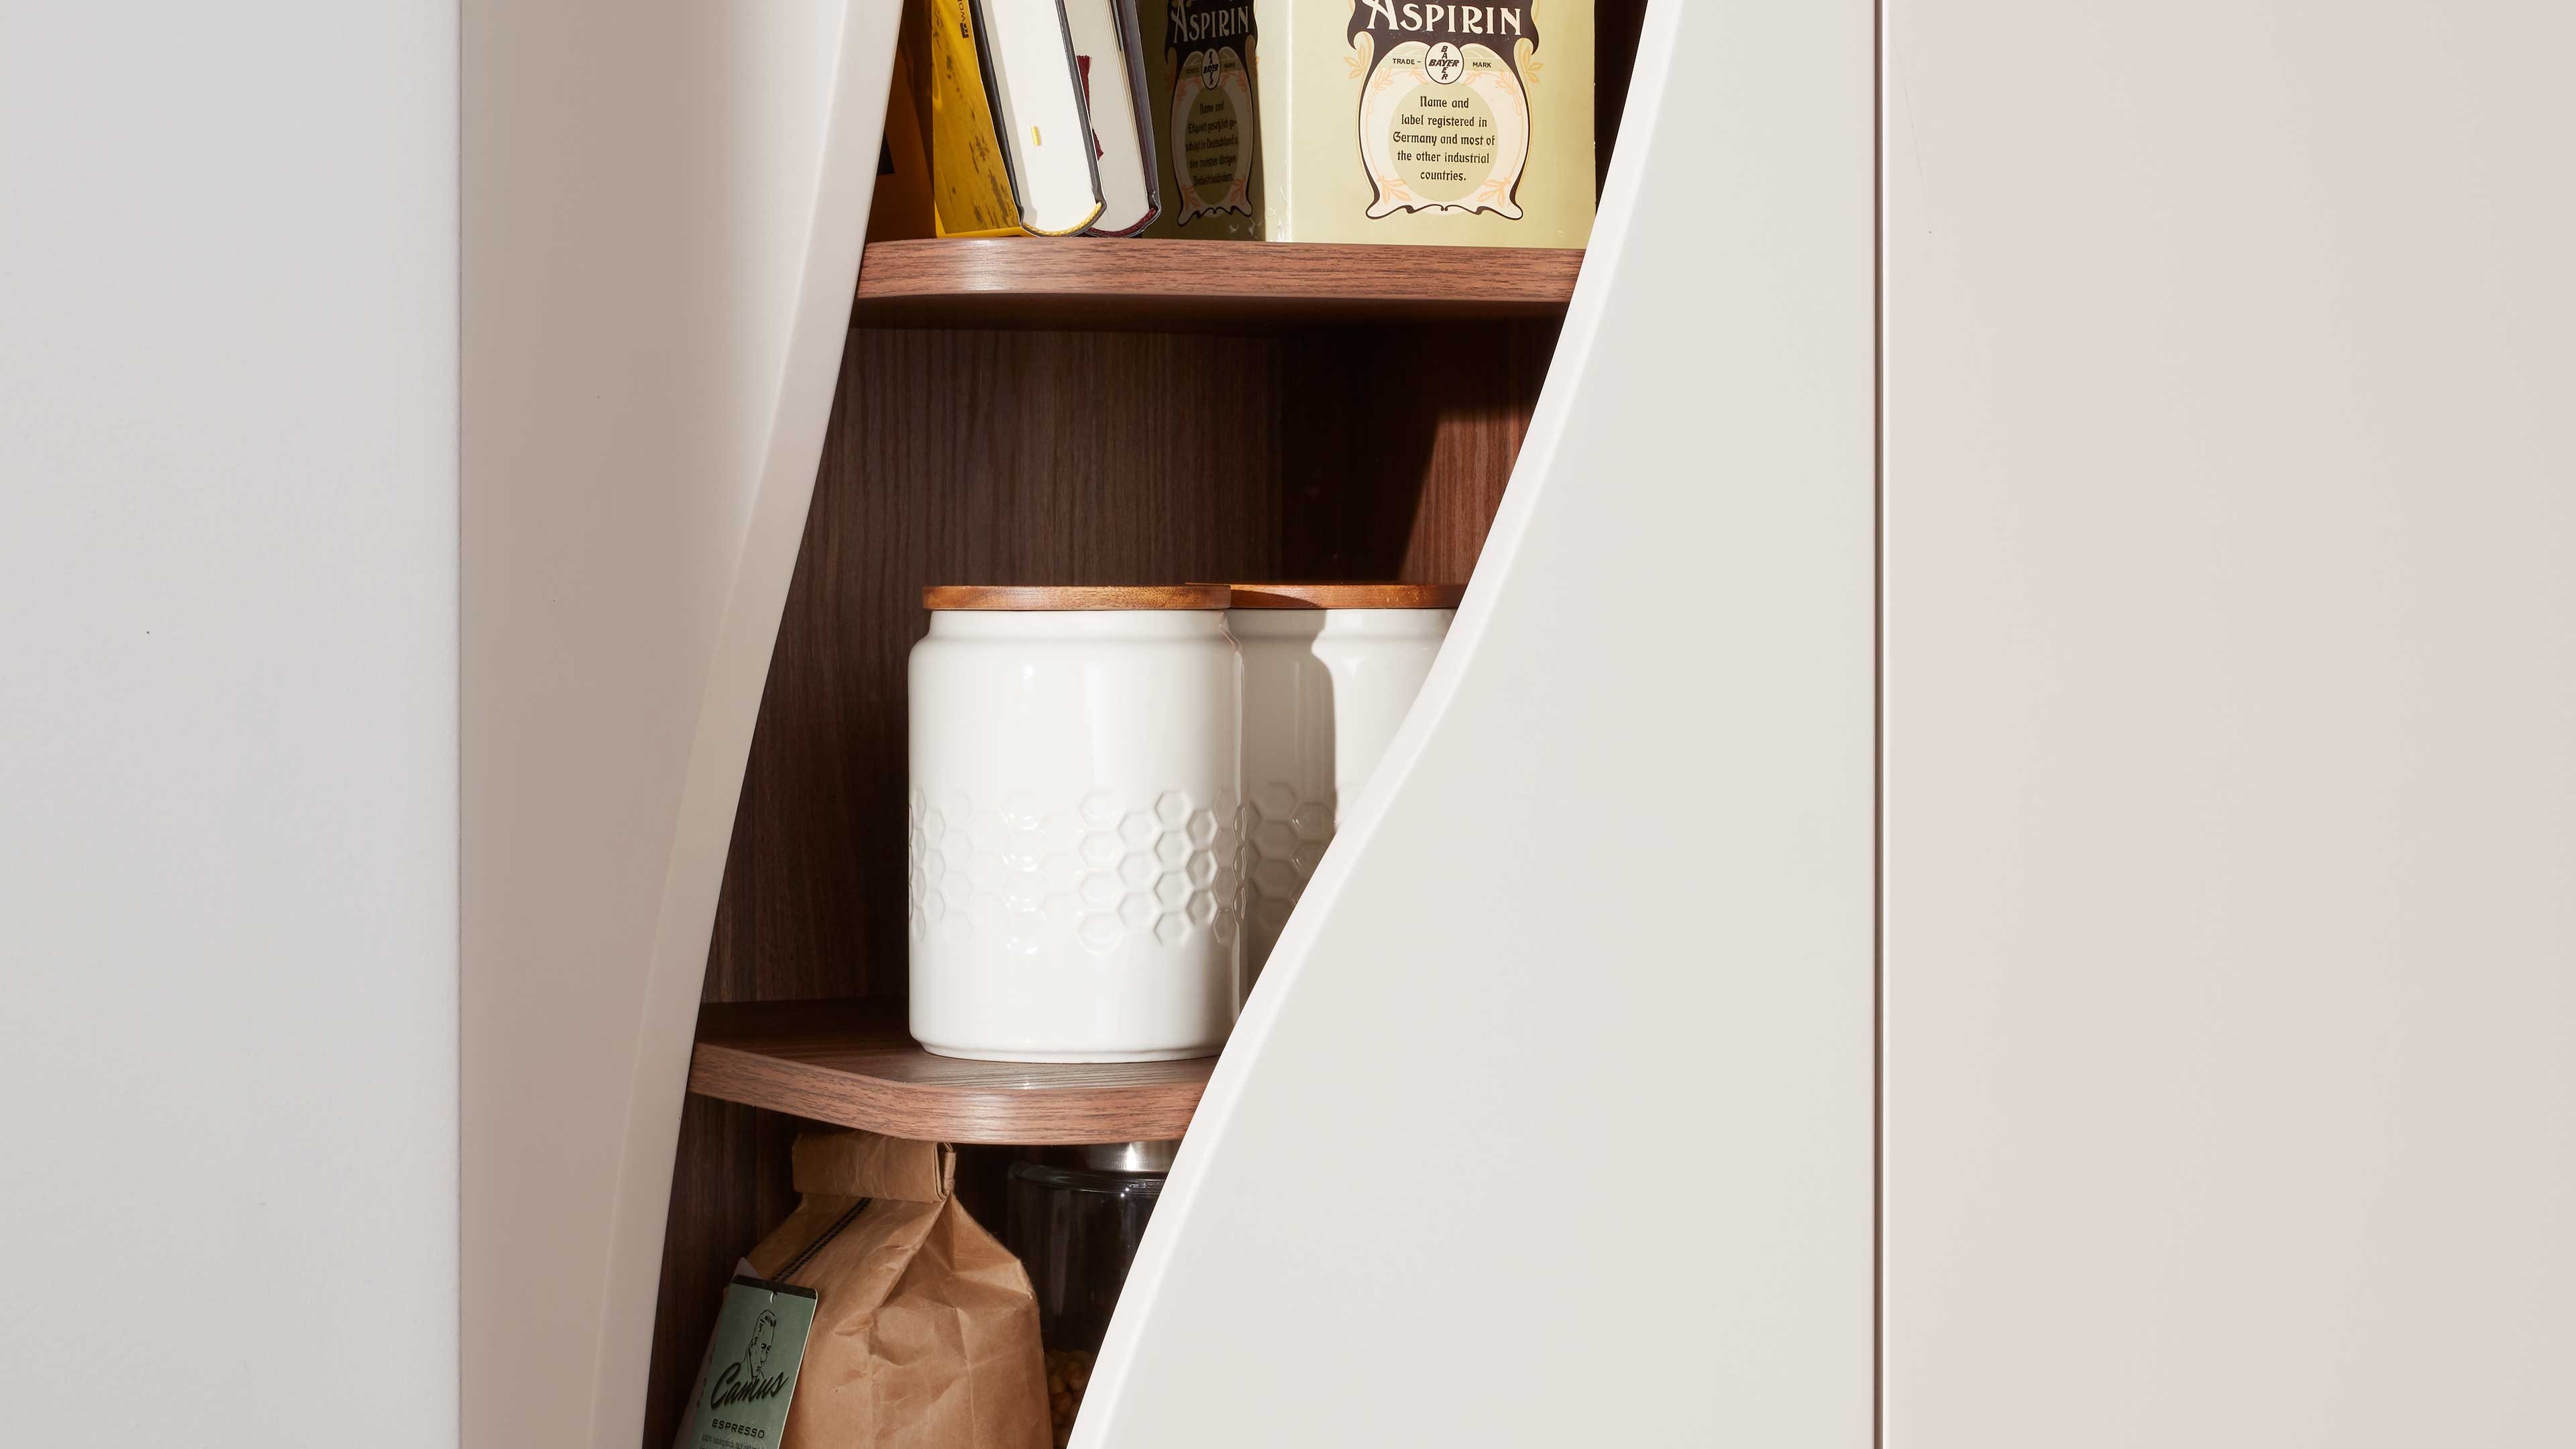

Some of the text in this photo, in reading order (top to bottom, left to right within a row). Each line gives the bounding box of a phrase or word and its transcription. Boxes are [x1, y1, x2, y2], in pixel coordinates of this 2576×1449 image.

[1171, 0, 1249, 44] ASPIRIN
[1362, 0, 1521, 36] ASPIRIN
[1428, 59, 1460, 67] BAYER
[1420, 96, 1469, 109] Name and
[1401, 114, 1487, 128] label registered in
[1393, 131, 1495, 146] Germany and most of
[1397, 150, 1490, 164] the other industrial
[1420, 170, 1466, 181] countries.
[710, 1362, 789, 1410] Camus
[712, 1419, 765, 1438] ESPRESSO
